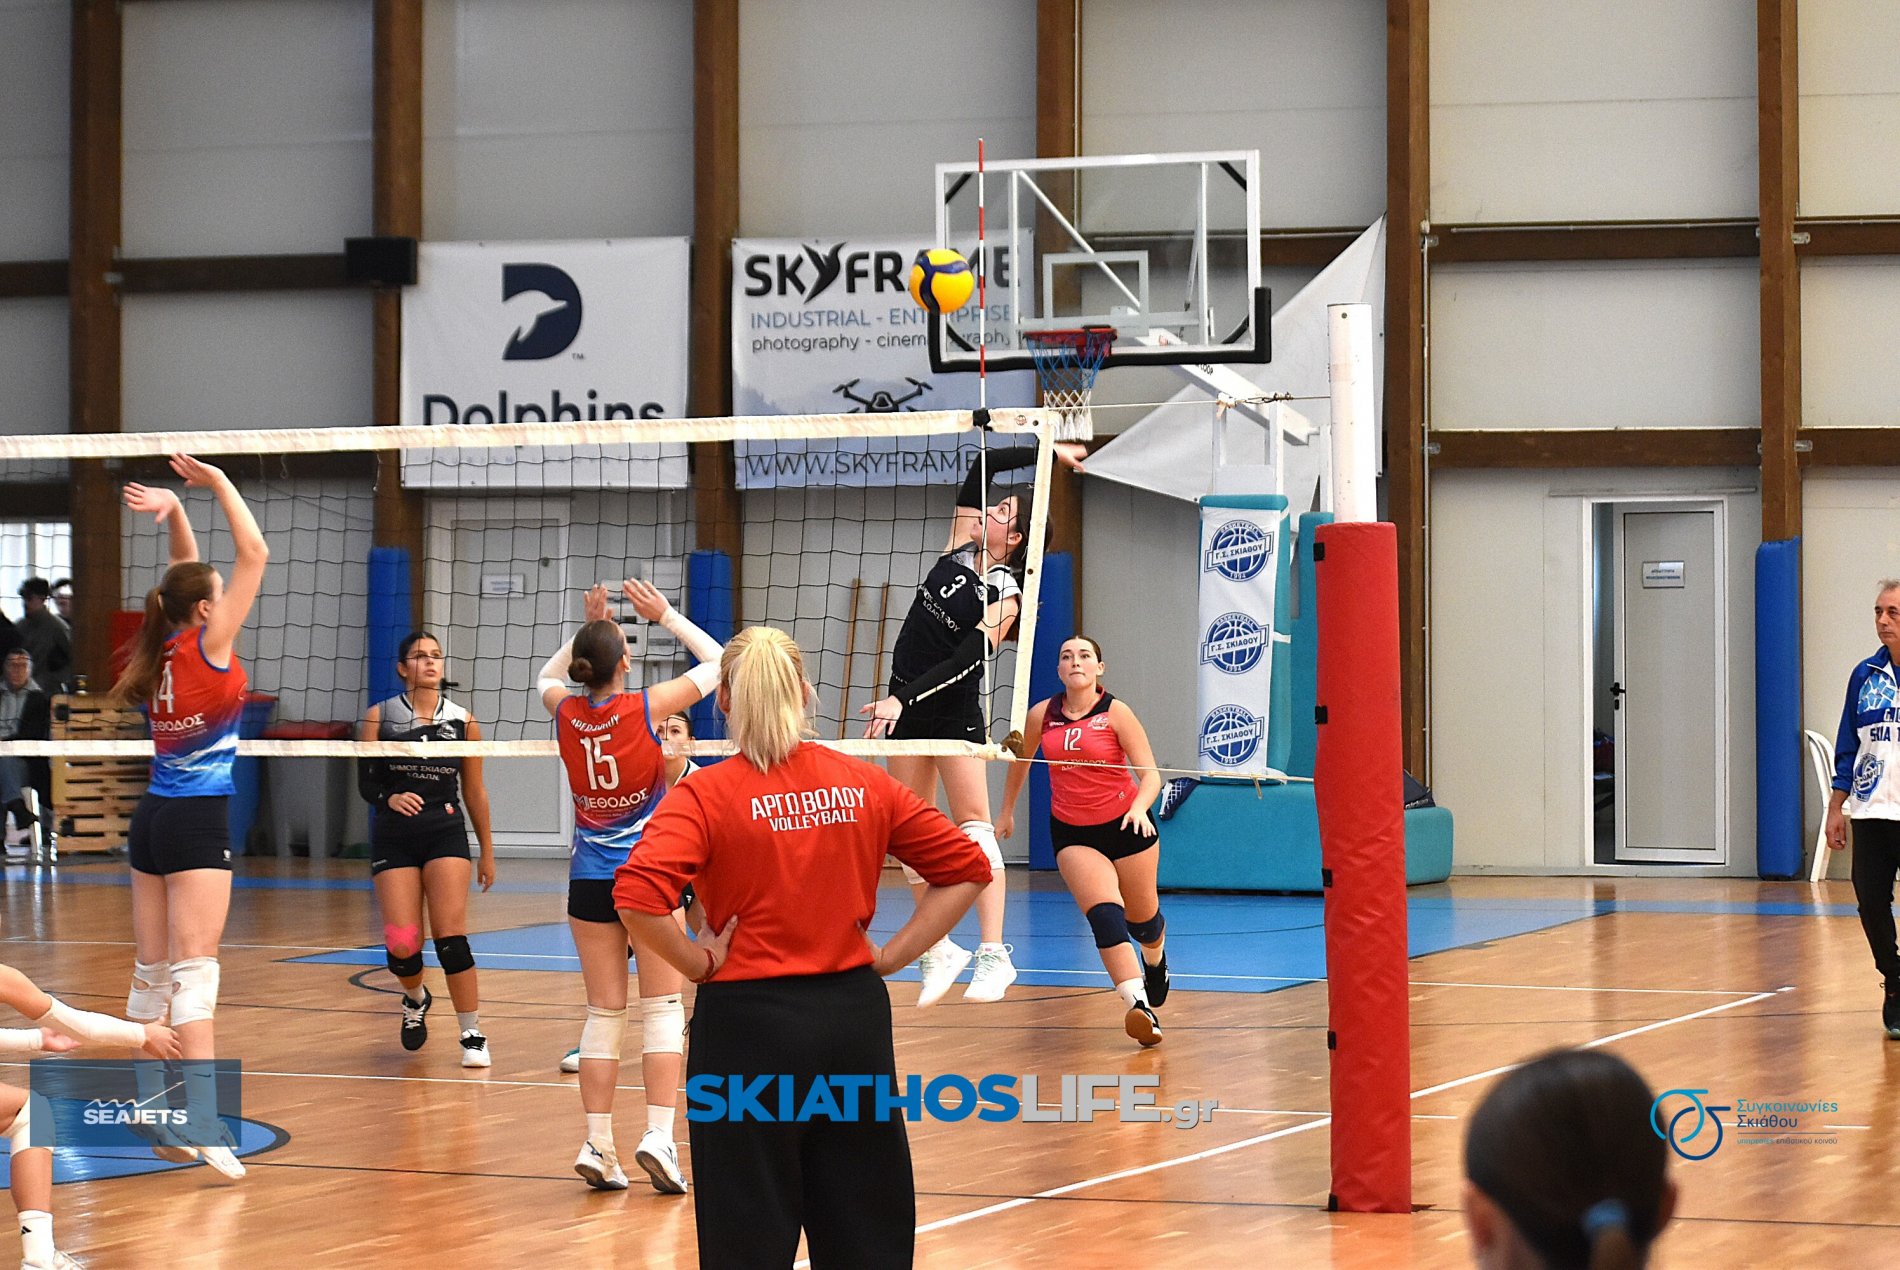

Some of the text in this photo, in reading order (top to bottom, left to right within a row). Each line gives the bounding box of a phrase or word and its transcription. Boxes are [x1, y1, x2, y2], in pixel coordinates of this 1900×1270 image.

[744, 242, 1020, 305] SKYFRME
[751, 309, 870, 330] INDUSTRIAL
[752, 333, 859, 353] photography
[746, 450, 980, 476] WWW.SKYFRAME
[1231, 544, 1263, 556] ΣΚΙΑΘΟΥ
[940, 574, 967, 599] 3
[1226, 636, 1258, 649] ΣΚΙΑΘΟΥ
[151, 713, 205, 732] ΕΘΟΔΟΣ
[1222, 729, 1253, 740] ΣΚΙΑΘΟΥ
[1063, 727, 1082, 751] 12
[580, 733, 619, 790] 15
[751, 787, 864, 820] ΑΡΓΩ ΒΟΛΟΥ
[769, 808, 857, 832] VOLLEYBALL
